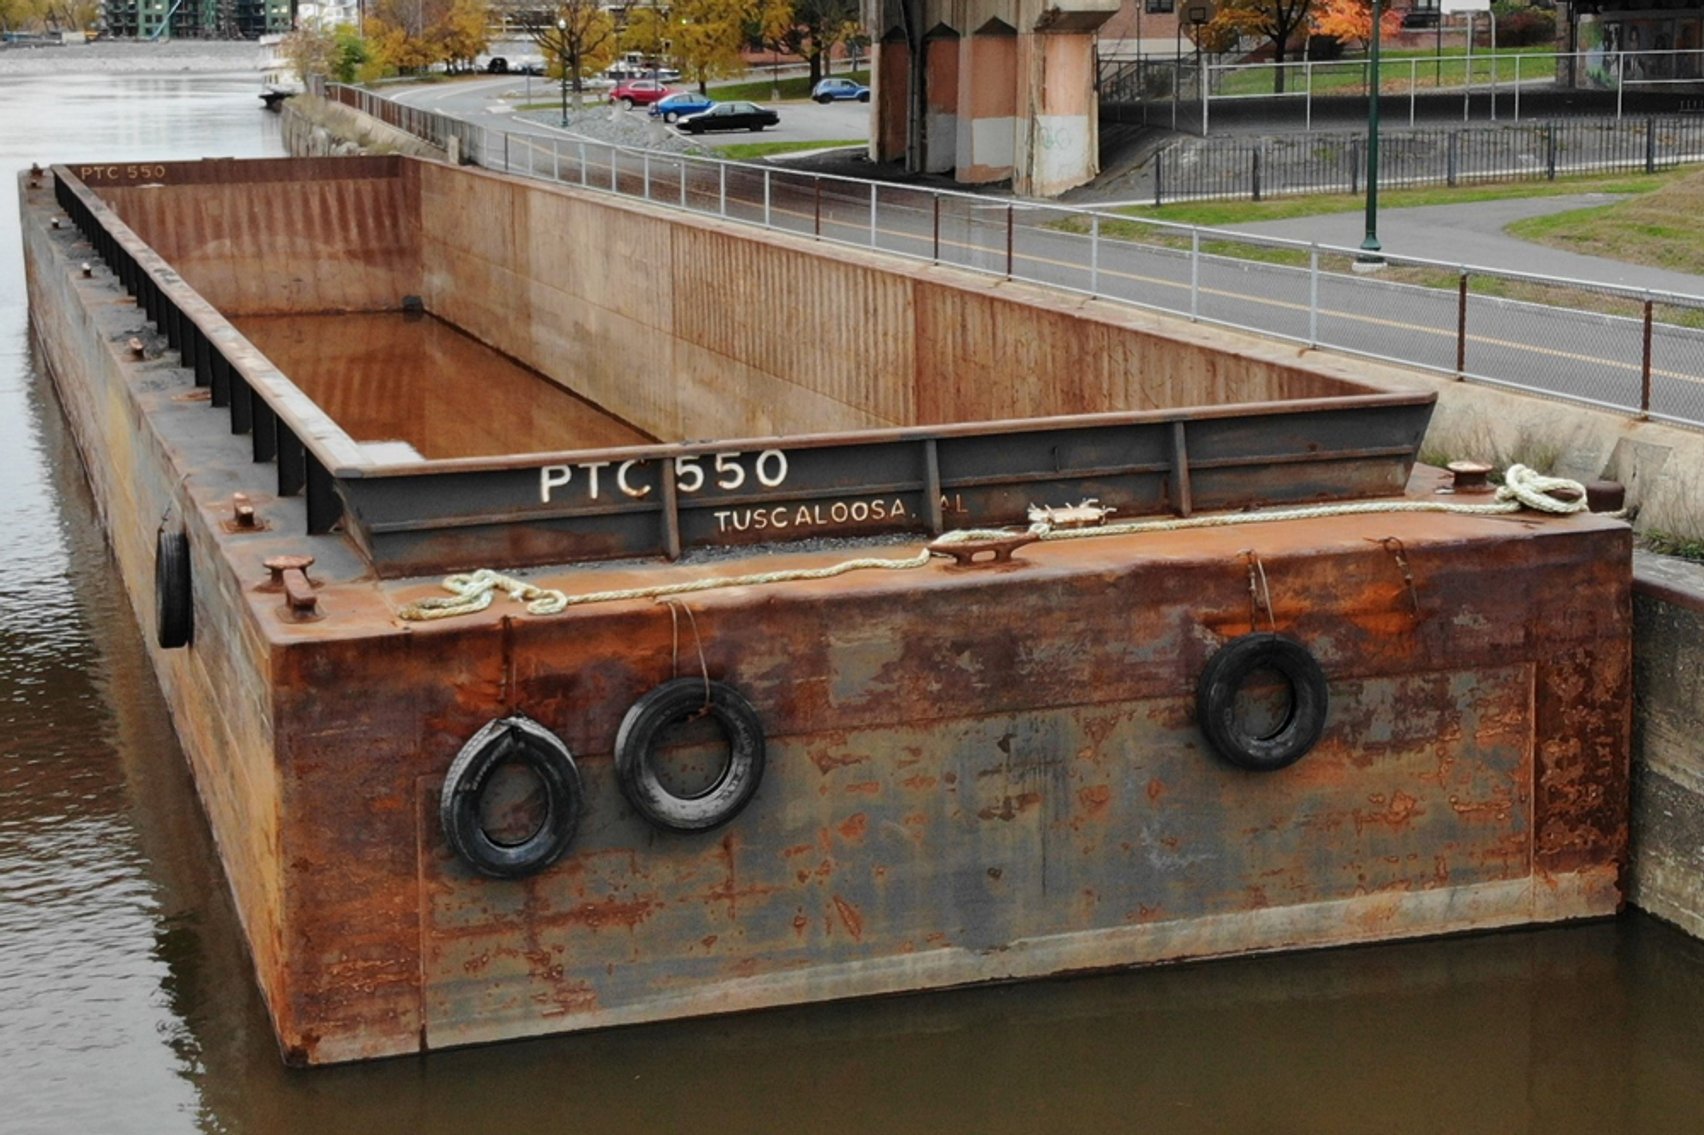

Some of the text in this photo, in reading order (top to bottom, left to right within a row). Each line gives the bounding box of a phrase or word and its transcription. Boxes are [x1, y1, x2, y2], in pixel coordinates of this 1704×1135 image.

[81, 164, 166, 180] PTC 550
[541, 449, 788, 503] PTC 550
[940, 494, 969, 513] AL
